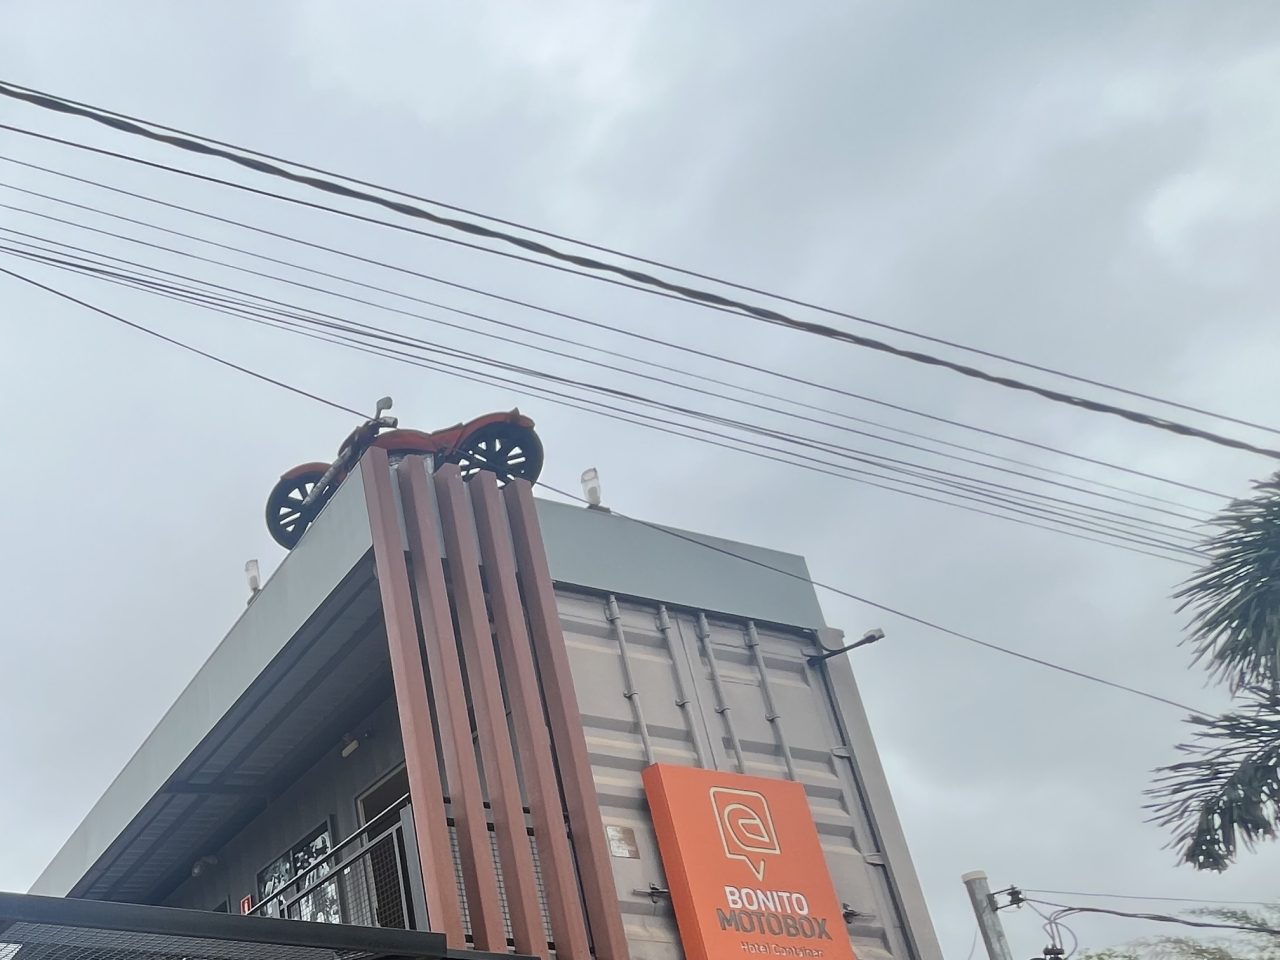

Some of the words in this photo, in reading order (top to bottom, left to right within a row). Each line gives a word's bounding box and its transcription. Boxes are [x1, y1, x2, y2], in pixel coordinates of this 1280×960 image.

[724, 885, 809, 915] BONITO
[717, 908, 833, 940] MOTOBOX
[741, 941, 771, 955] Hotel
[772, 943, 823, 958] Container
